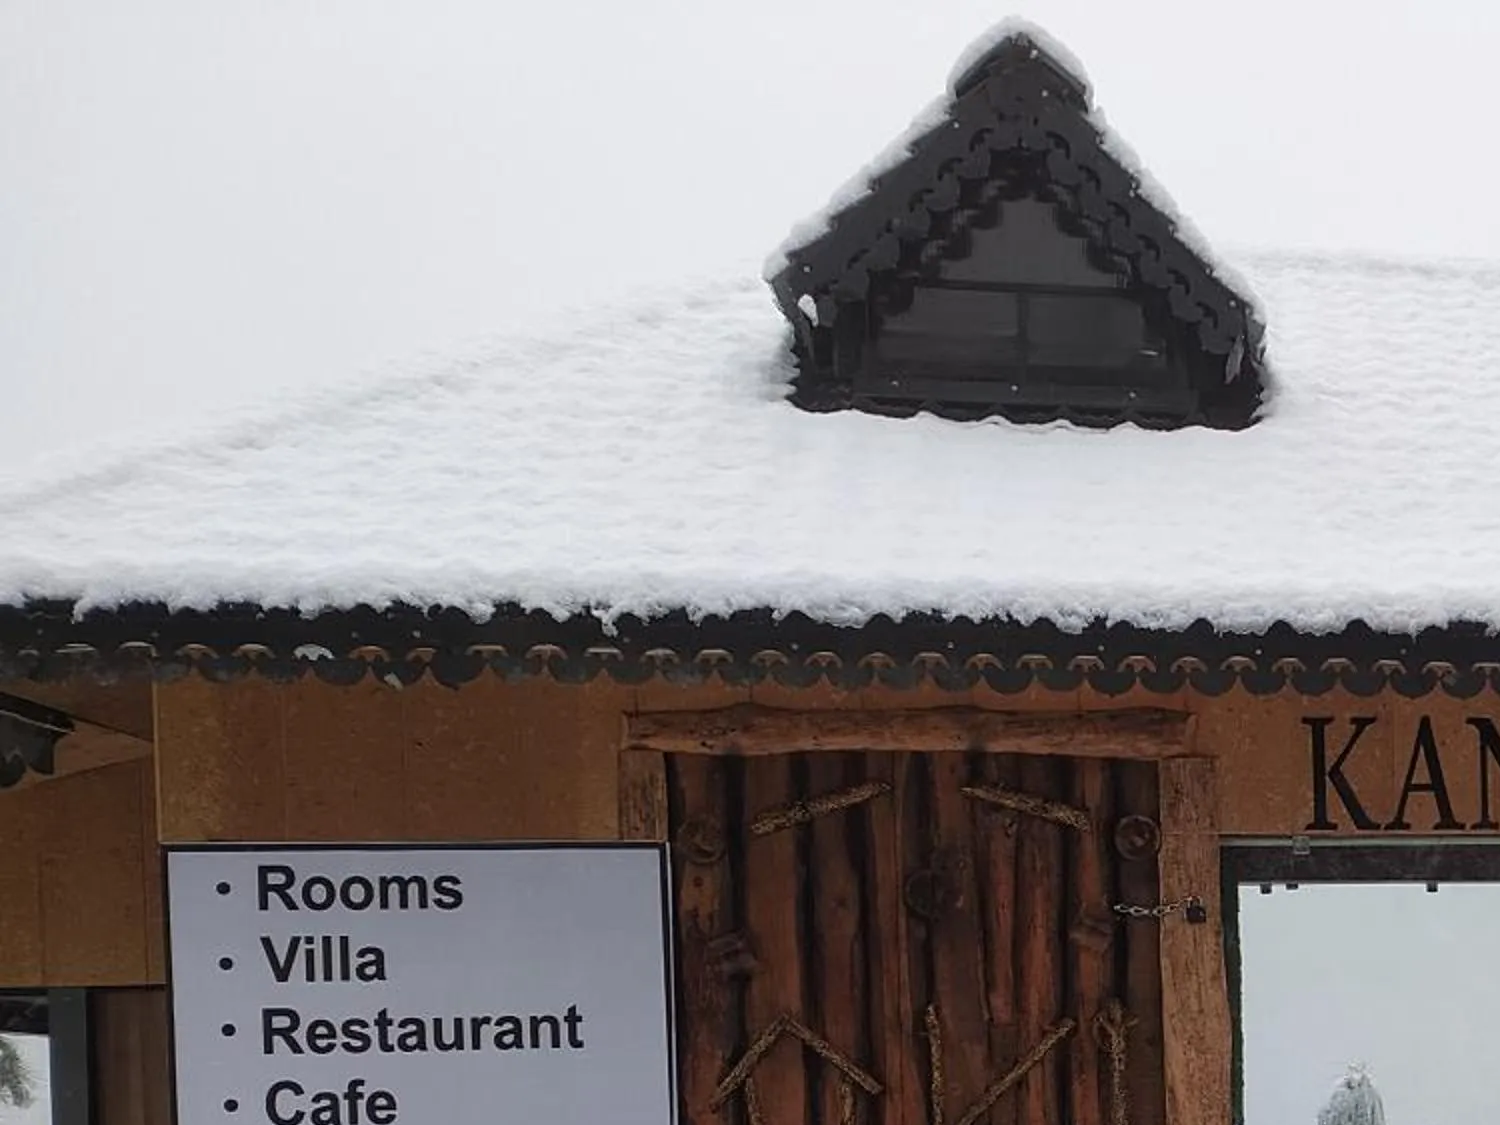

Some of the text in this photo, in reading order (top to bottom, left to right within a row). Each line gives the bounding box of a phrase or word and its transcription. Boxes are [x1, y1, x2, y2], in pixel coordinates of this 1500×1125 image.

[256, 864, 465, 912] Rooms
[259, 935, 388, 983] Villa
[261, 1003, 585, 1055] Restaurant
